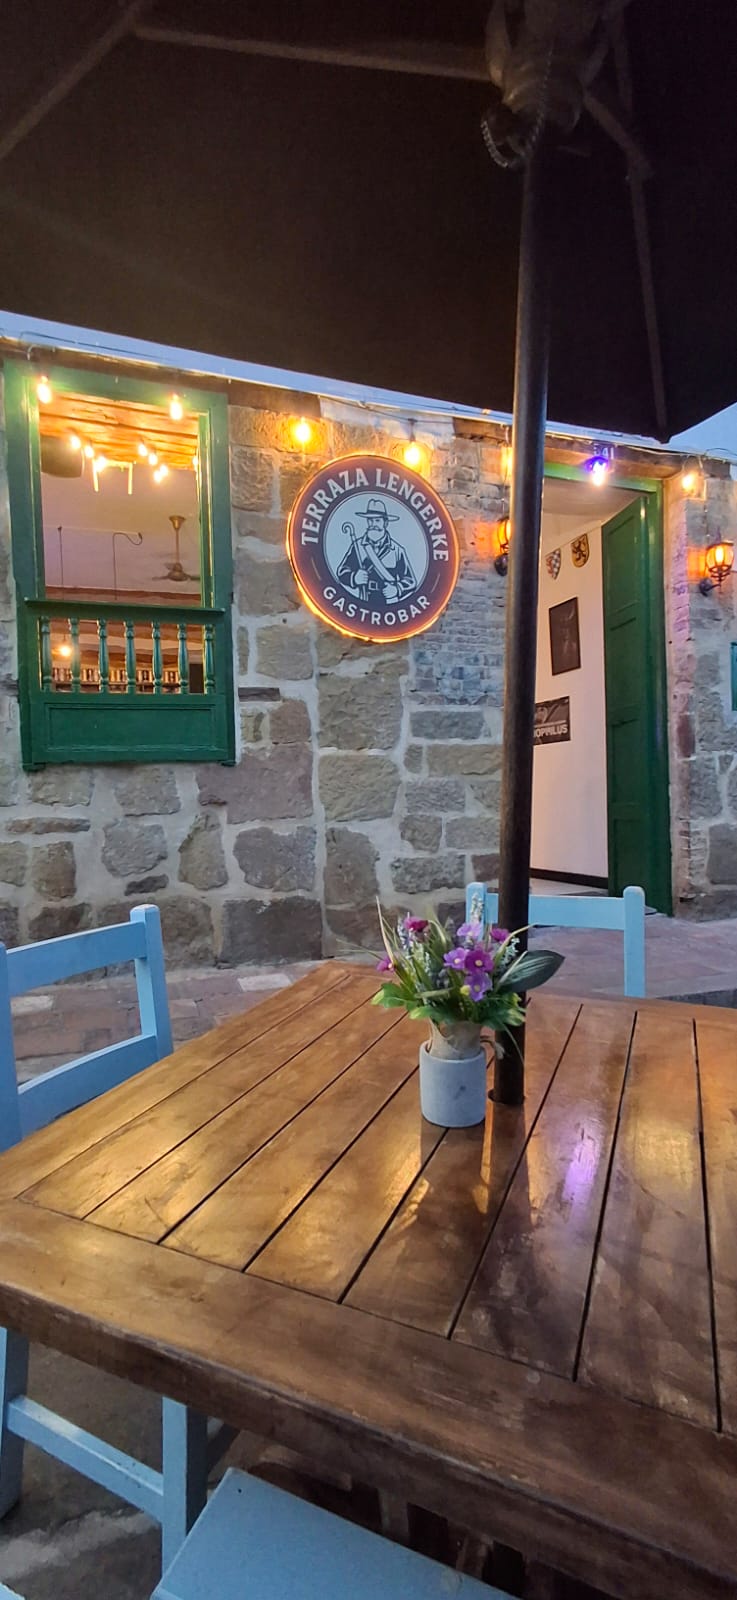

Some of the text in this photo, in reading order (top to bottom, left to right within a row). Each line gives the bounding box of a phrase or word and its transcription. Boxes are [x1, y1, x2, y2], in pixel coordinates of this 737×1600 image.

[301, 468, 449, 562] TERRAZA LENGERKE
[323, 586, 431, 625] GASTROBAR
